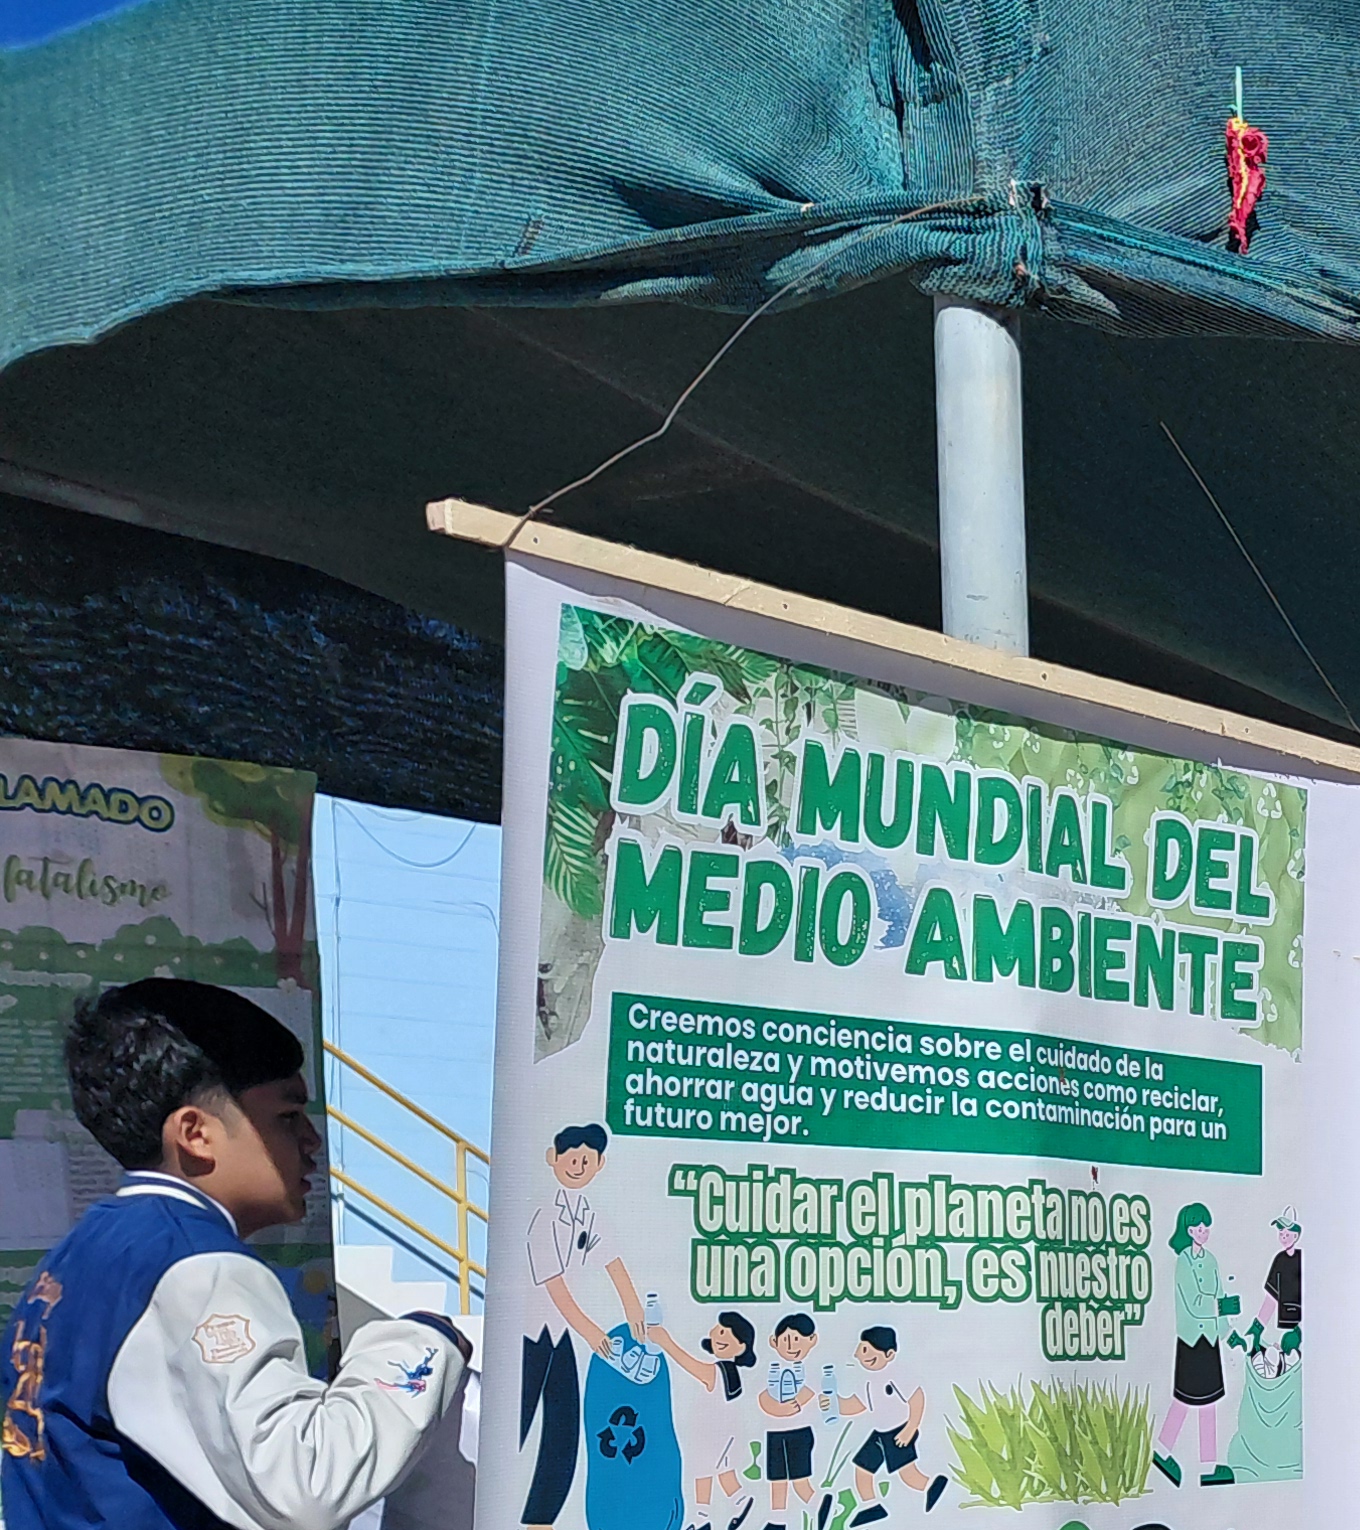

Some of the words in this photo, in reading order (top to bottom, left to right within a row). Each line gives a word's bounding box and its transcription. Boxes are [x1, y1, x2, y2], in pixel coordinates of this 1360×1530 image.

[618, 682, 761, 827] DÍA
[796, 738, 1125, 890] MUNDIAL
[1151, 818, 1271, 919] DEL
[609, 837, 871, 967] MEDIO
[905, 887, 1260, 1022] AMBIENTE
[627, 1039, 780, 1073] naturaleza
[787, 1053, 803, 1083] y
[810, 1053, 970, 1088] motivemos
[977, 1066, 1079, 1097] acciones
[1084, 1081, 1137, 1105] como
[1142, 1085, 1224, 1117] reciclar,
[628, 1003, 756, 1039] Creemos
[762, 1020, 913, 1054] conciencia
[919, 1033, 1002, 1060] sobre
[1008, 1038, 1031, 1062] el
[1036, 1043, 1112, 1074] cuidado
[1116, 1054, 1140, 1078] de
[1145, 1056, 1164, 1081] la
[624, 1098, 713, 1130] futuro
[720, 1110, 810, 1142] mejor.
[625, 1068, 735, 1101] ahorrar
[741, 1081, 813, 1112] agua
[819, 1087, 837, 1116] y
[843, 1086, 945, 1115] reducir
[952, 1091, 978, 1117] la
[985, 1098, 1145, 1132] contaminación
[1149, 1115, 1197, 1140] para
[1201, 1120, 1227, 1140] un
[849, 1176, 891, 1237] el
[904, 1179, 1063, 1246] planeta
[1071, 1193, 1105, 1243] no
[1112, 1197, 1149, 1245] es
[695, 1243, 777, 1298] una
[789, 1232, 957, 1307] opción,
[971, 1248, 1028, 1299] es
[1039, 1246, 1149, 1300] nuestro
